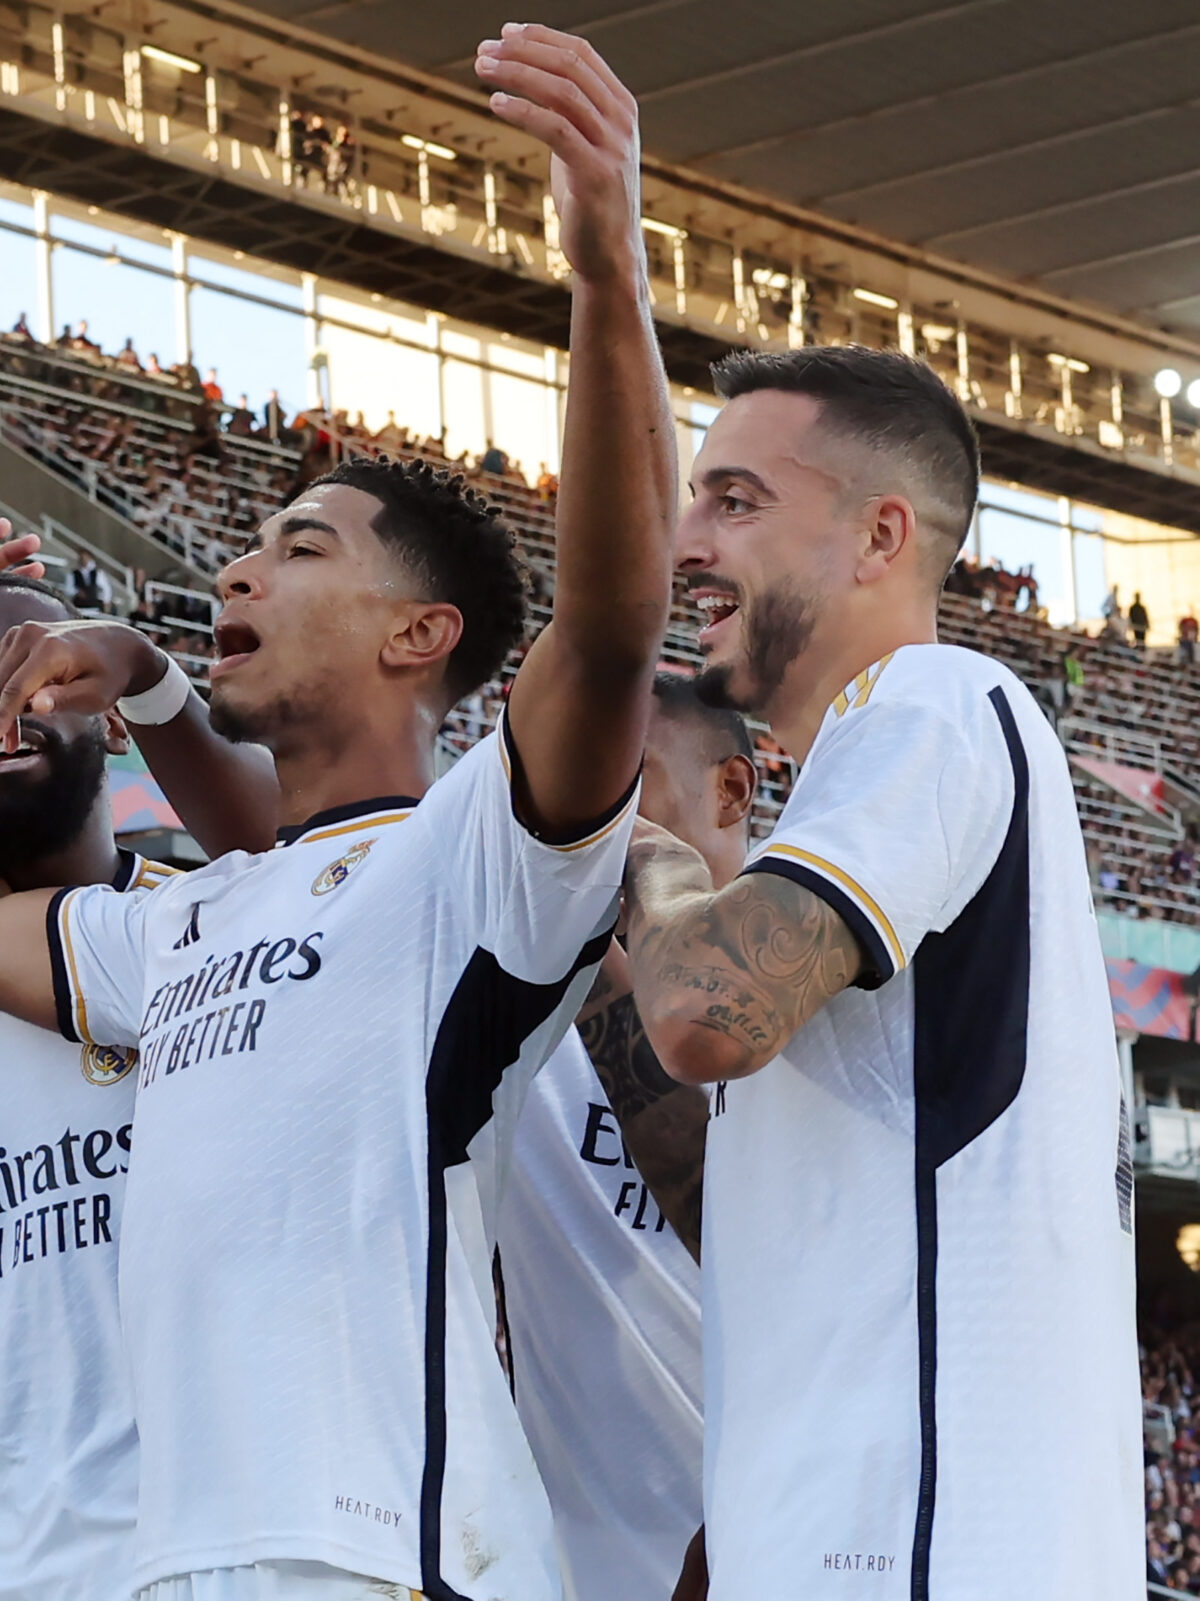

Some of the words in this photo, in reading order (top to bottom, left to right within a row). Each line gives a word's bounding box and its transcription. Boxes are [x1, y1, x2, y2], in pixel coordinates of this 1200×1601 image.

[140, 931, 324, 1038] Emirates
[164, 998, 267, 1076] BETTER
[12, 1193, 112, 1269] BETTER
[823, 1553, 896, 1572] HEAT.RDY
